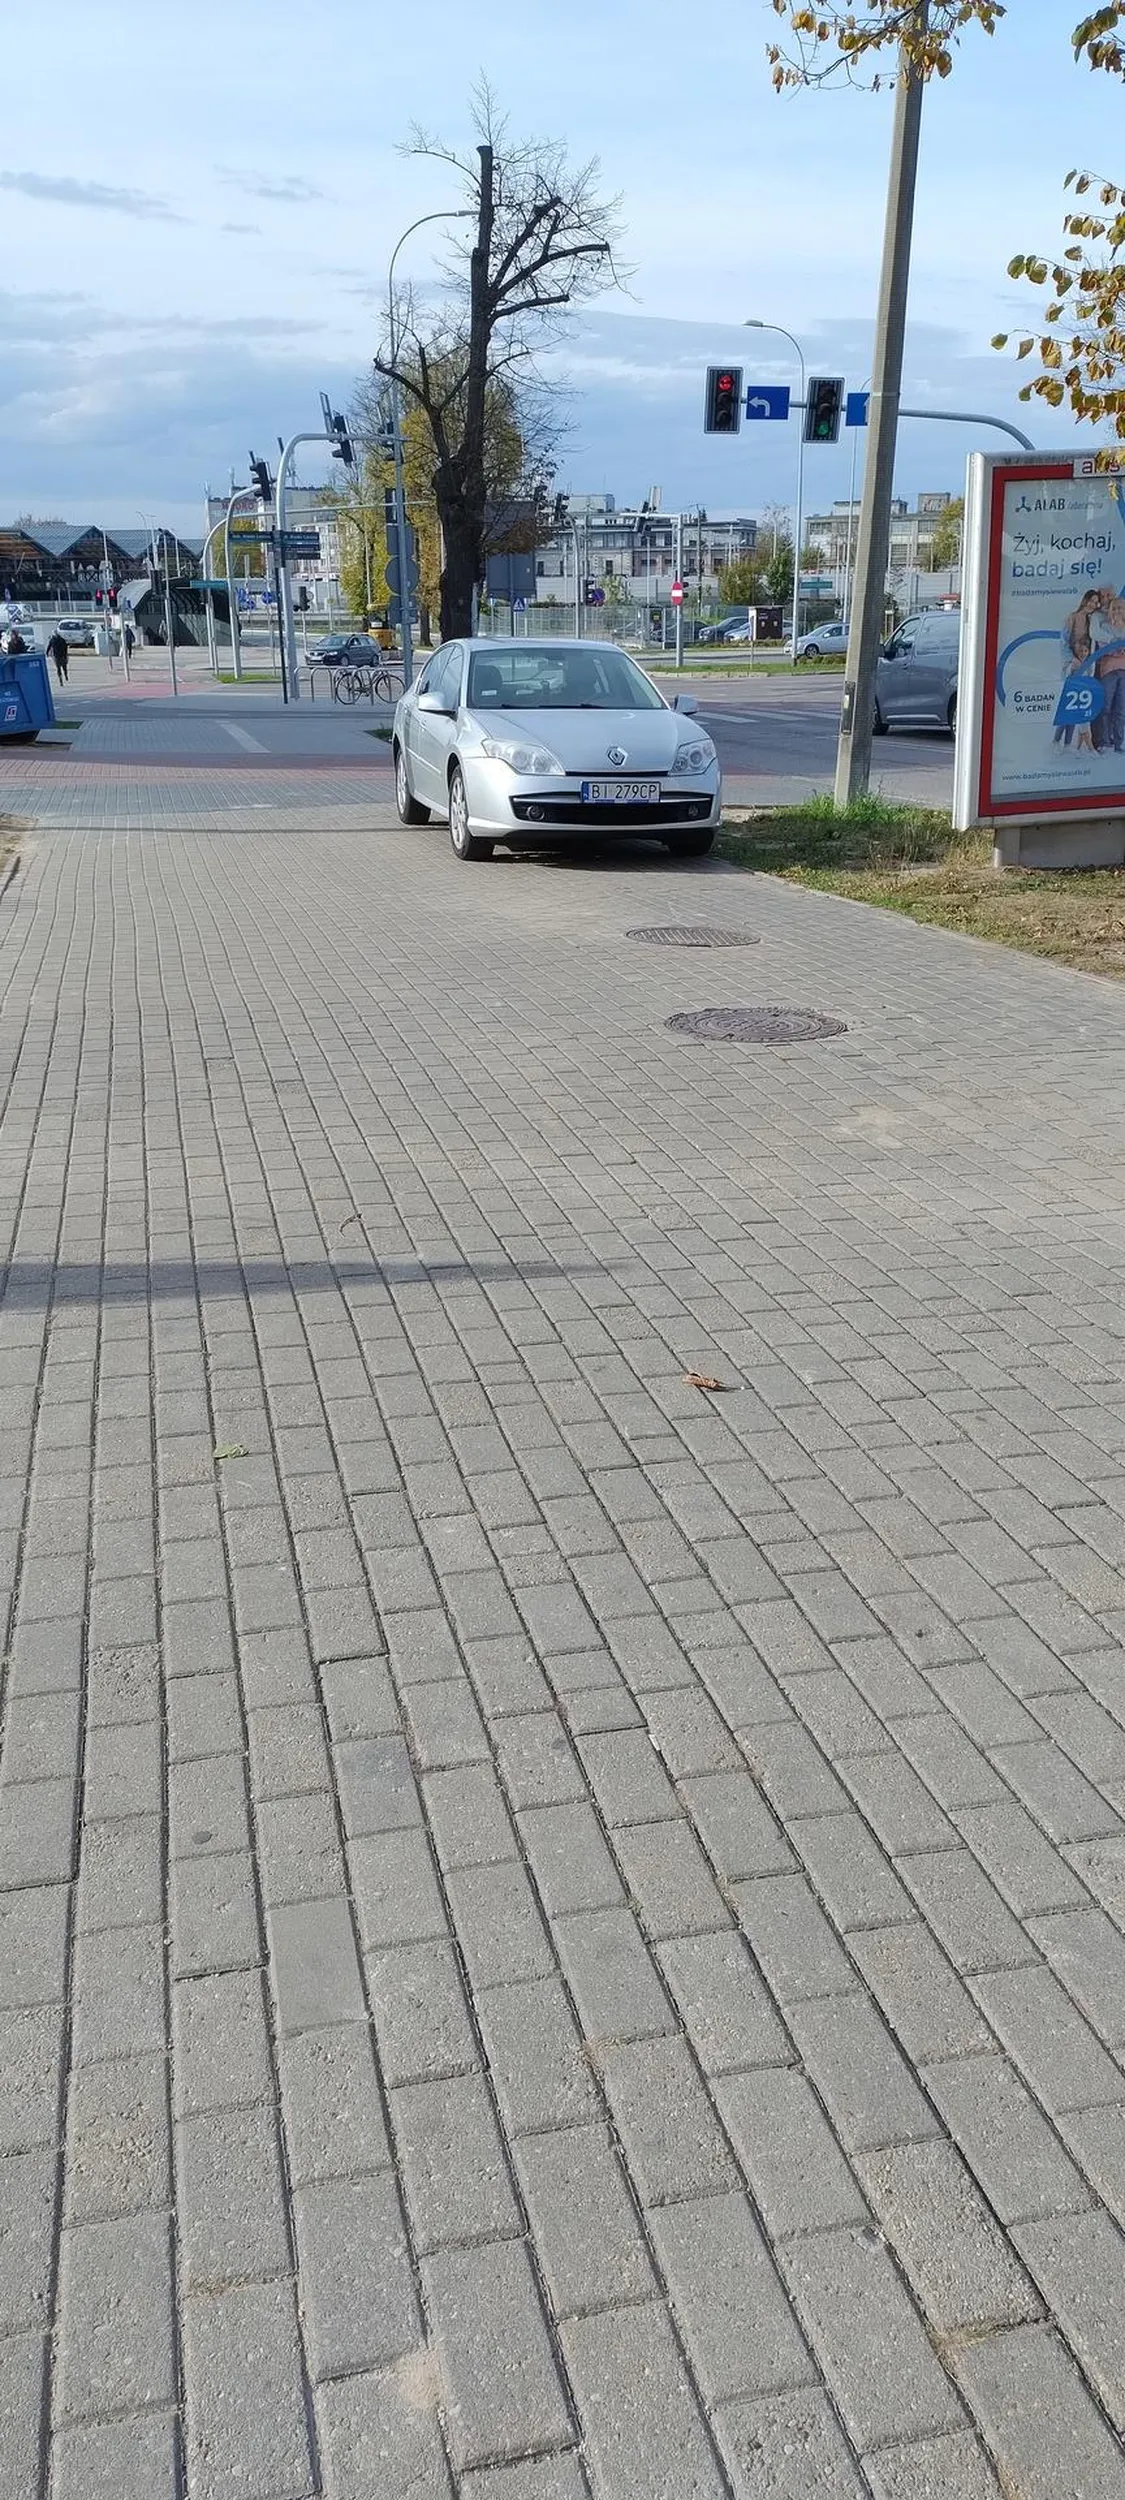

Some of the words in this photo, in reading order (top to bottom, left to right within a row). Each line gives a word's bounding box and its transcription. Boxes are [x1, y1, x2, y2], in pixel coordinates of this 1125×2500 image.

[1082, 460, 1120, 474] as
[1013, 532, 1044, 556] Żyj,
[1050, 531, 1116, 553] kochaj,
[1012, 560, 1065, 580] badaj
[1070, 558, 1102, 579] się!
[1014, 691, 1023, 703] 6
[1065, 690, 1093, 710] 29
[1026, 704, 1052, 713] CENIE
[592, 785, 608, 798] BI
[615, 785, 657, 799] 279CP
